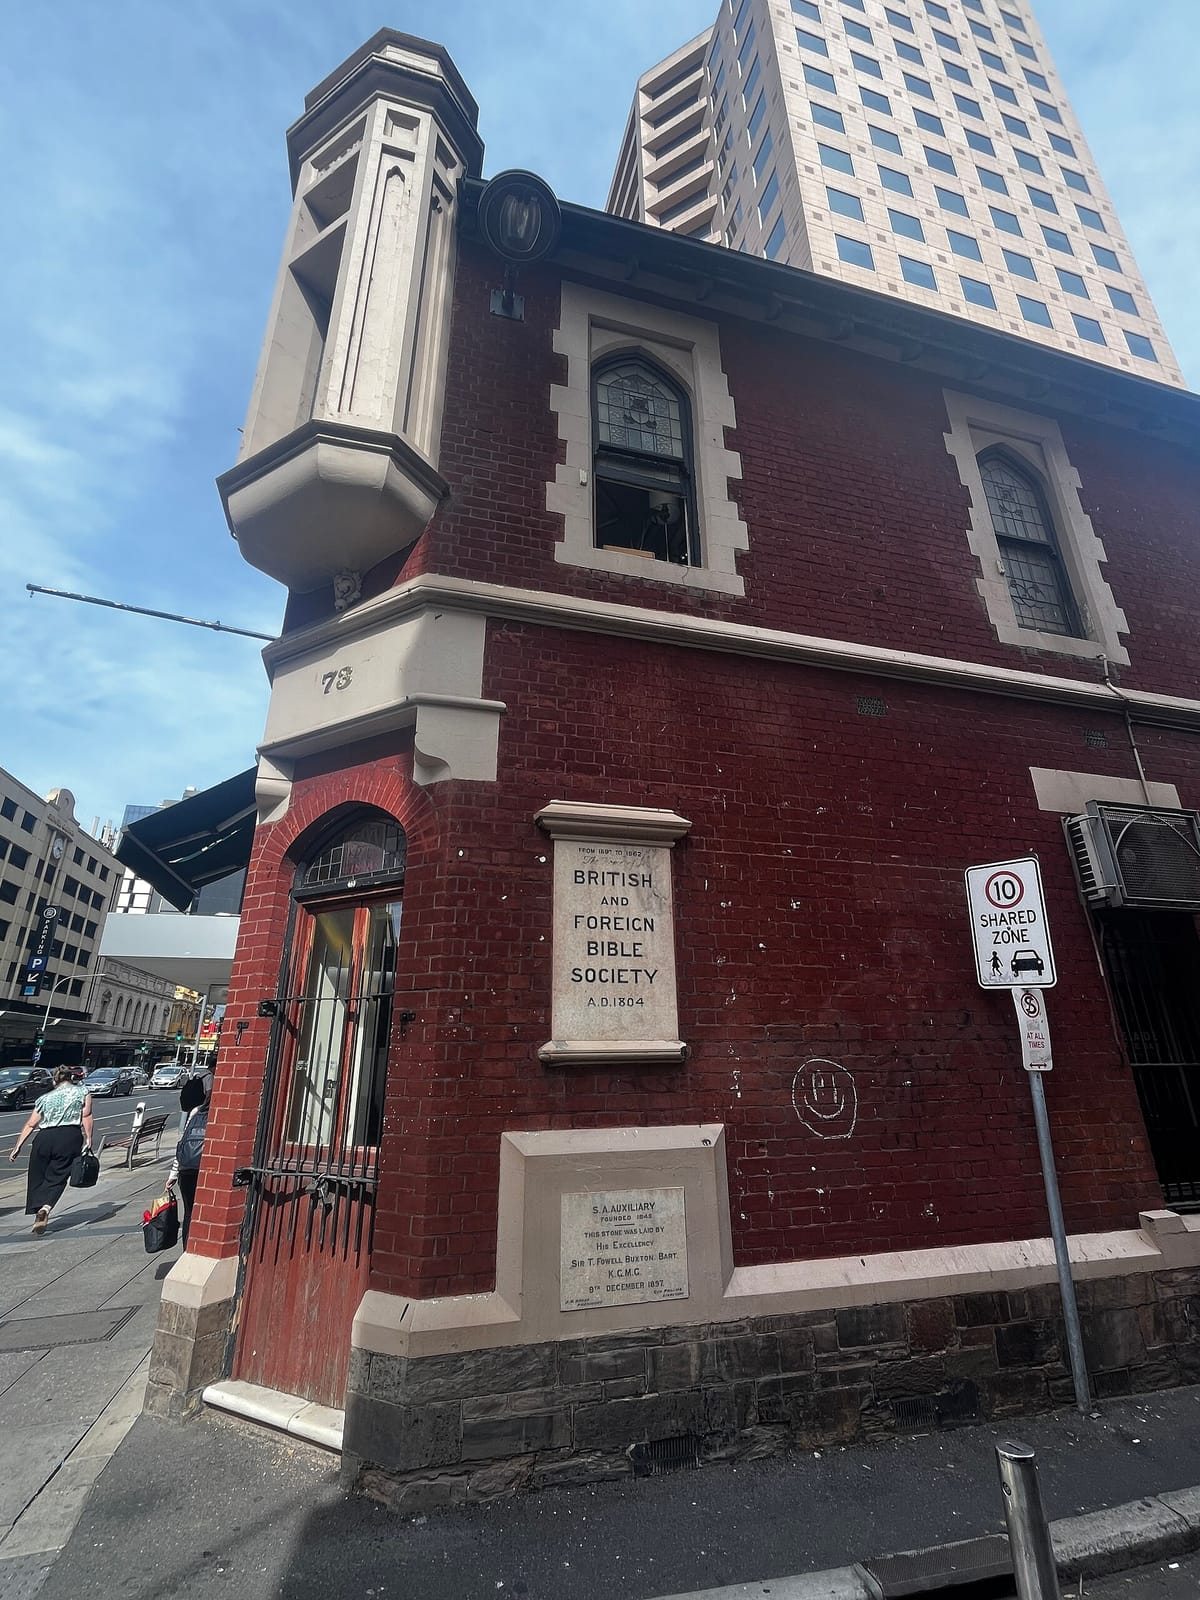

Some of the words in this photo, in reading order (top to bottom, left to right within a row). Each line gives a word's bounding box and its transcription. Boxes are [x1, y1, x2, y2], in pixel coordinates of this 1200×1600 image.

[321, 666, 353, 694] 73
[574, 870, 653, 888] BRITISH
[993, 879, 1016, 901] 10
[600, 896, 629, 906] AND
[574, 915, 655, 932] FOREIGN
[980, 909, 1037, 927] SHARED
[36, 919, 50, 955] PARKING
[992, 928, 1030, 945] ZONE
[587, 941, 643, 957] BIBLE
[31, 958, 43, 969] P
[571, 967, 658, 984] SOCIETY
[1026, 1031, 1033, 1040] AT
[1035, 1031, 1045, 1040] ALL
[1028, 1040, 1045, 1049] TIMES
[584, 1231, 600, 1239] THIS
[606, 1281, 645, 1292] DECEMBER
